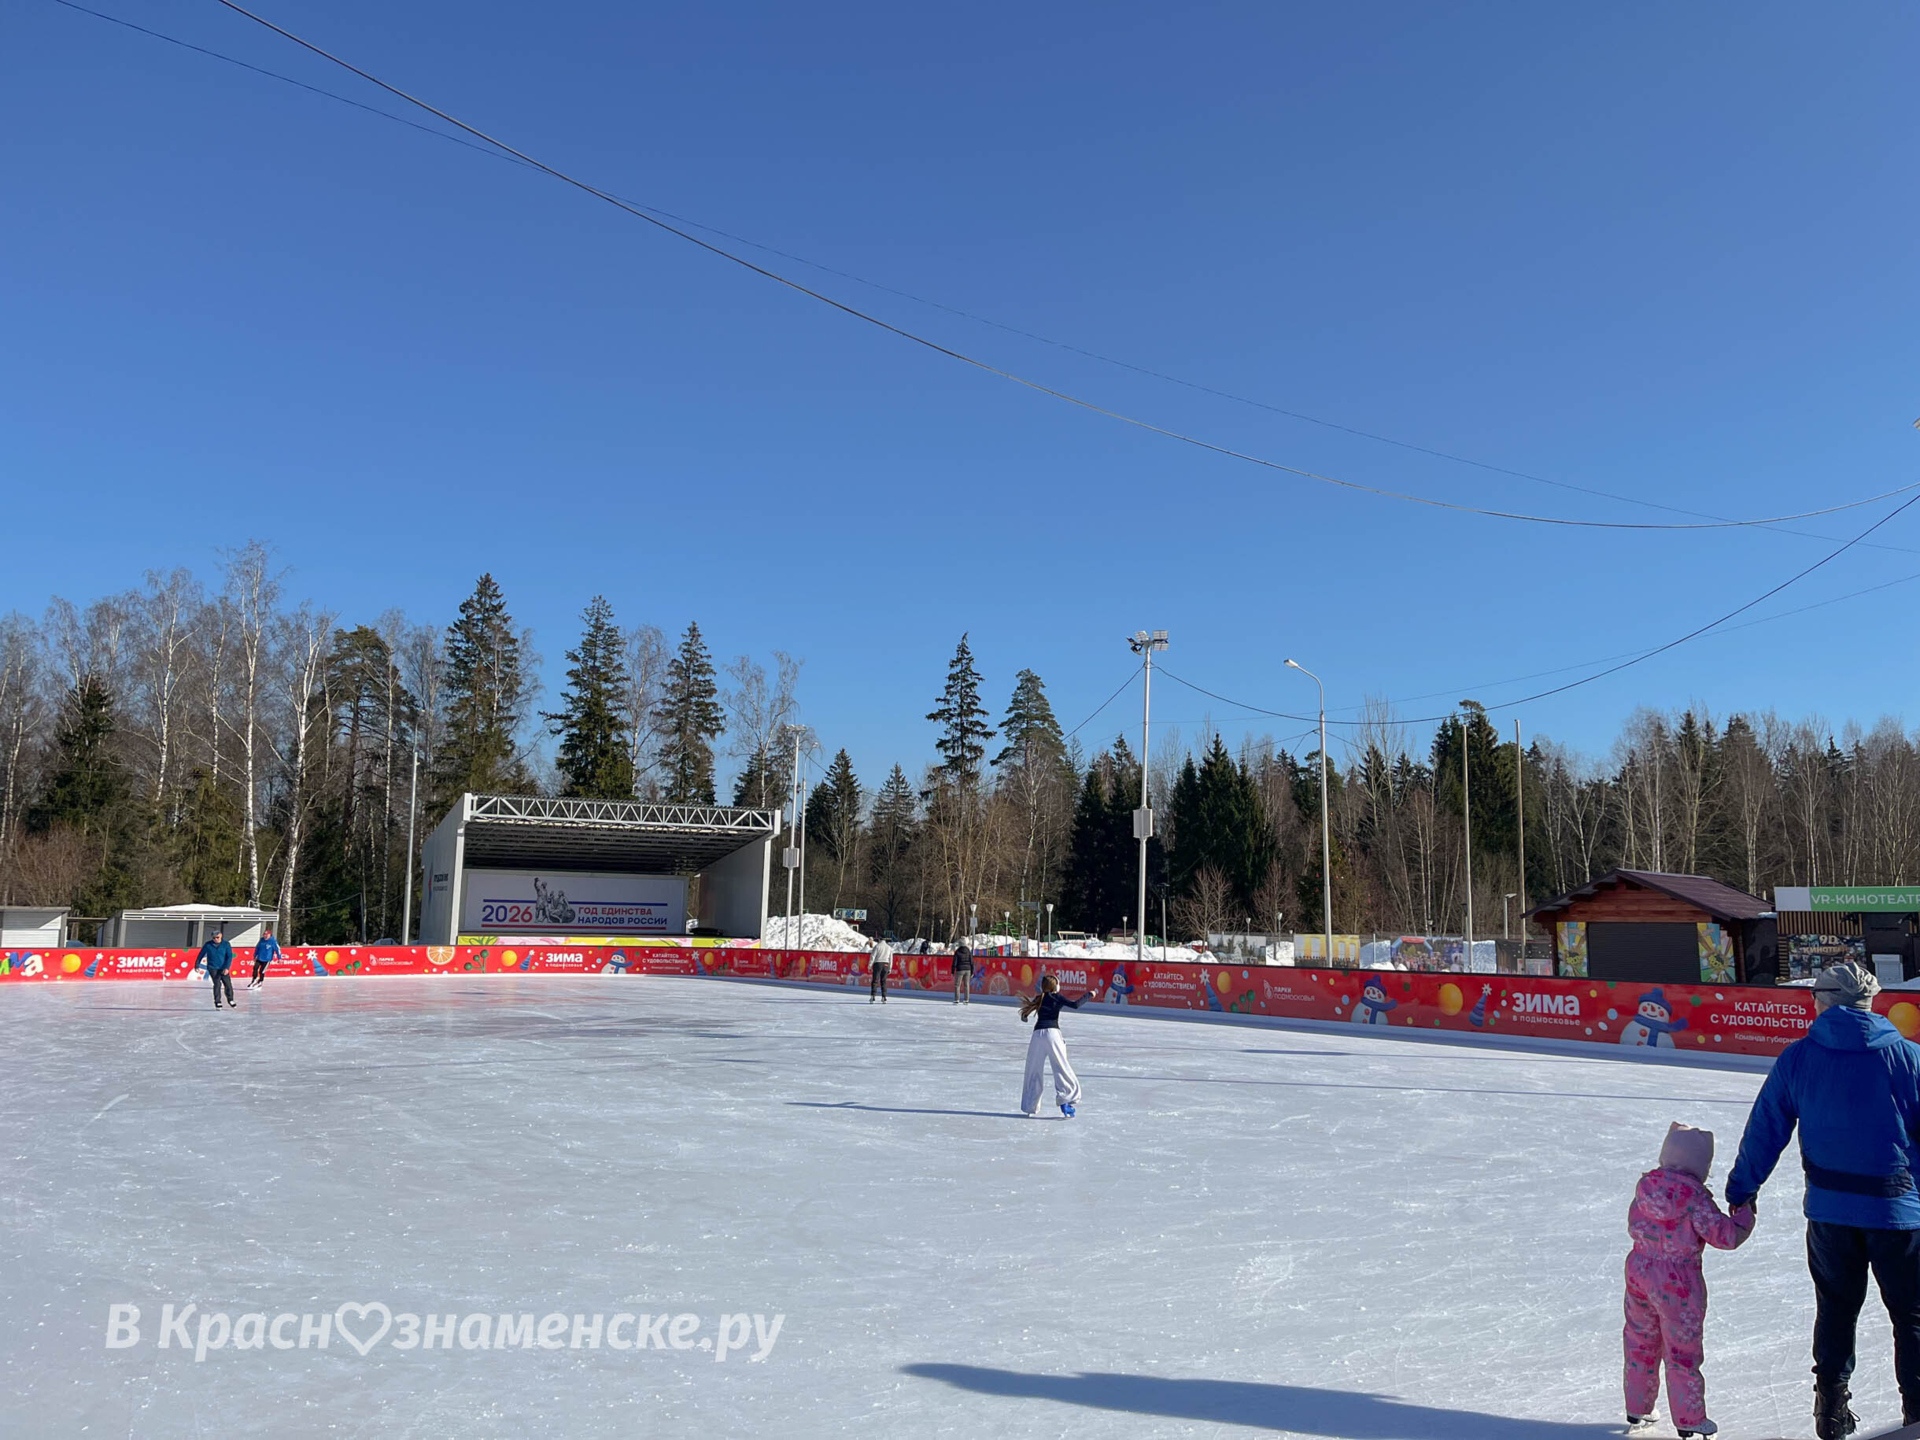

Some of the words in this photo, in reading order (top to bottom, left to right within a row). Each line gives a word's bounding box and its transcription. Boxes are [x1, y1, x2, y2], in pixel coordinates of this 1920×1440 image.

[482, 905, 533, 922] 2026
[579, 907, 598, 915] ГОД
[601, 907, 652, 915] ЕДИНСТВА
[578, 917, 625, 925] НАРОДОВ
[628, 917, 667, 925] РОССИИ
[1734, 1001, 1807, 1015] КАТАЙТЕСЬ
[1710, 1013, 1719, 1024] С
[1721, 1014, 1814, 1030] УДОВОЛЬСТВИ
